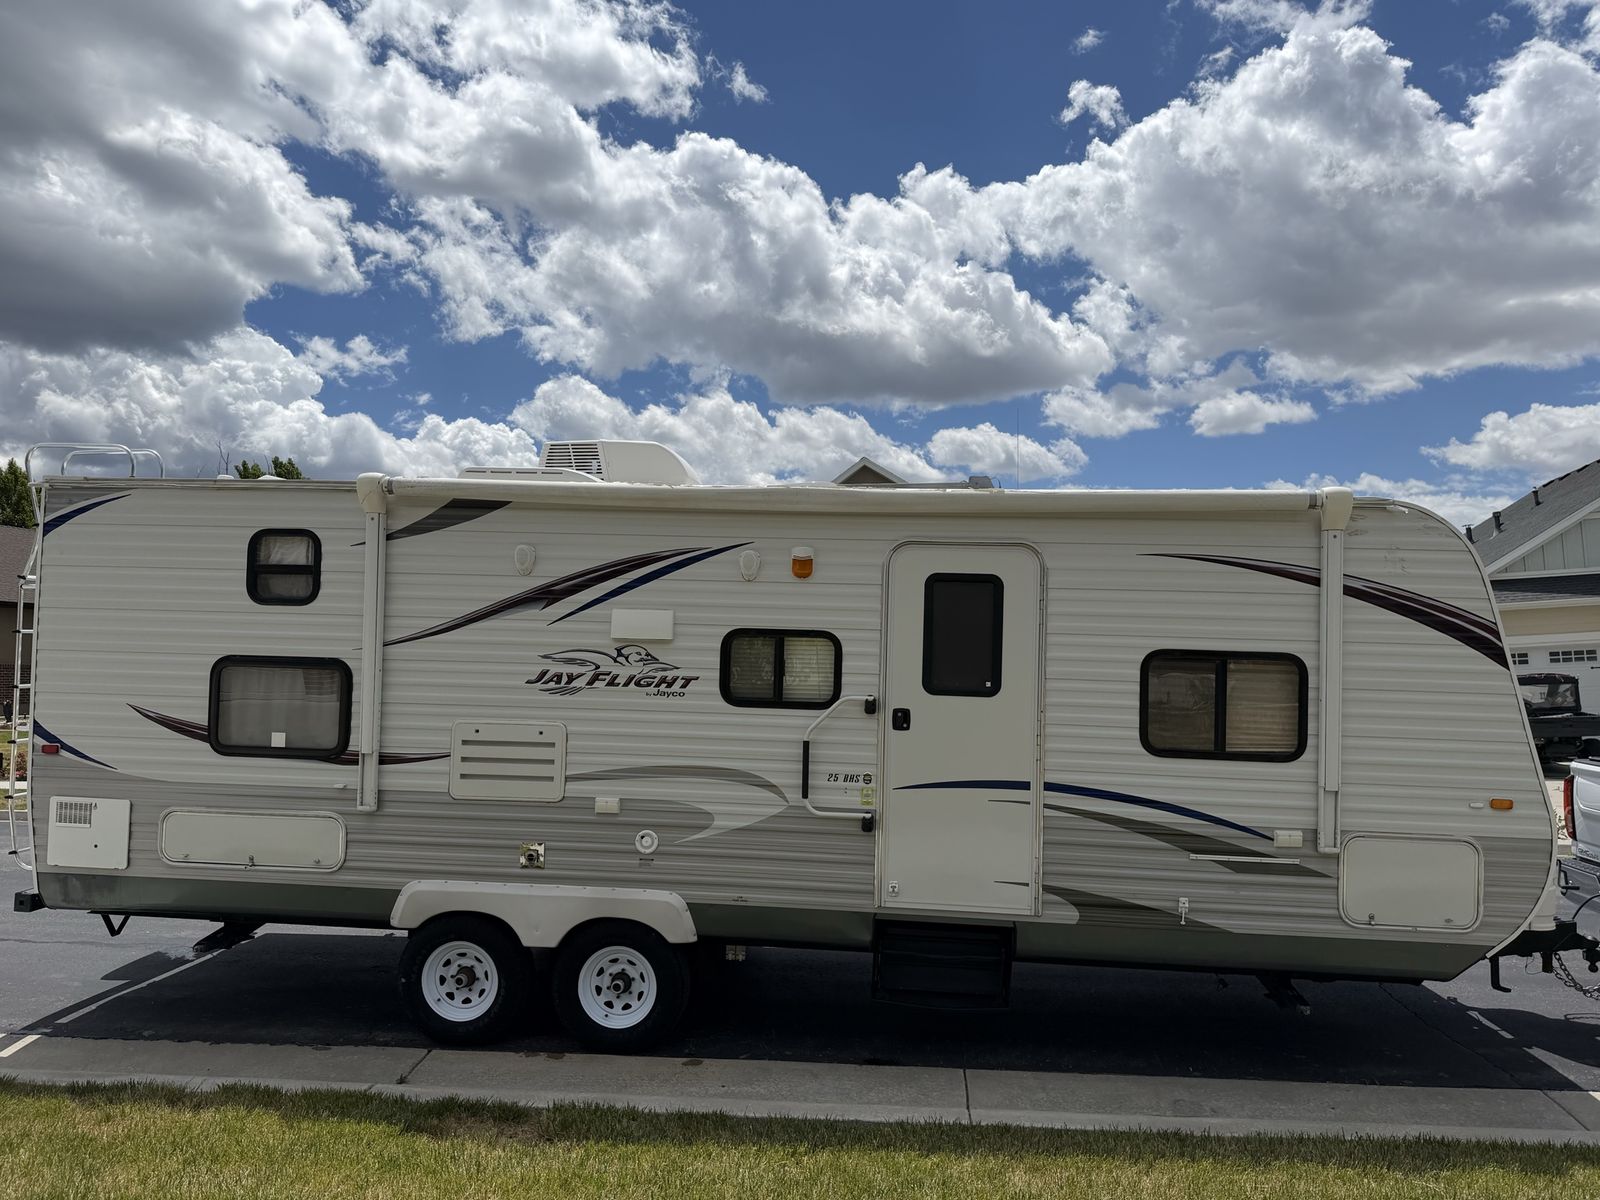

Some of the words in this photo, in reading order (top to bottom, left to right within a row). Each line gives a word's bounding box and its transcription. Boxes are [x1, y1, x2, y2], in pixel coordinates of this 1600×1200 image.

[526, 669, 587, 686] JAY
[585, 671, 700, 689] FLIGHT
[653, 689, 686, 698] Jayco
[827, 773, 840, 783] 25
[843, 774, 861, 783] BHS
